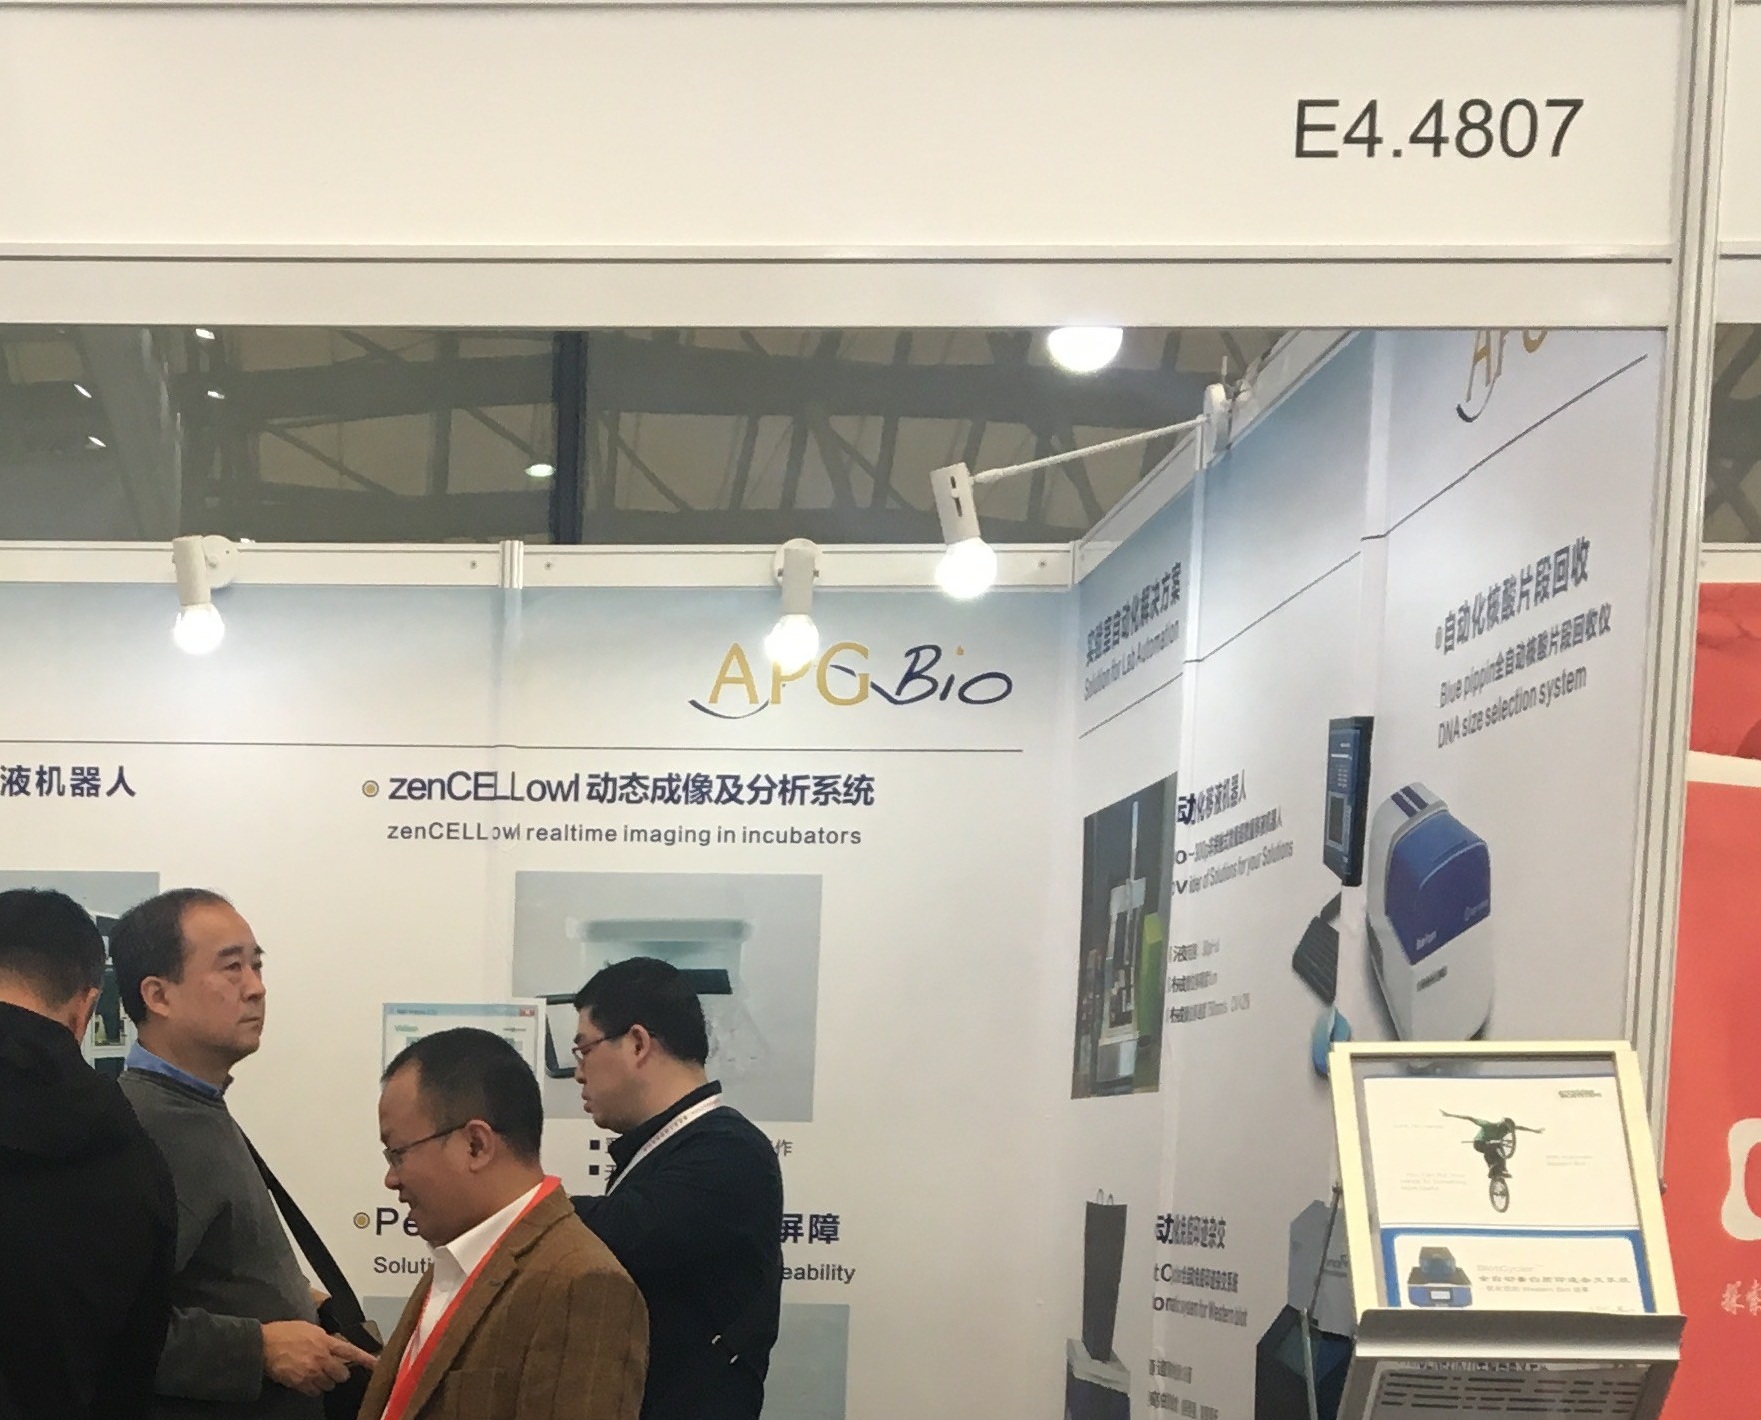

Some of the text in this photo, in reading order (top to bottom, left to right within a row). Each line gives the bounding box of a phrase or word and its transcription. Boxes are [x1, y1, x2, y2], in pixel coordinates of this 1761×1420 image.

[1294, 97, 1585, 158] E4.4807
[1462, 709, 1483, 737] size
[1484, 686, 1537, 727] selection
[1538, 666, 1587, 707] system
[586, 771, 876, 806] 动态成像及分析系统
[525, 822, 618, 844] realtime
[623, 822, 712, 847] imaging
[716, 823, 736, 845] in
[741, 823, 862, 846] incubators
[782, 1264, 856, 1284] eability
